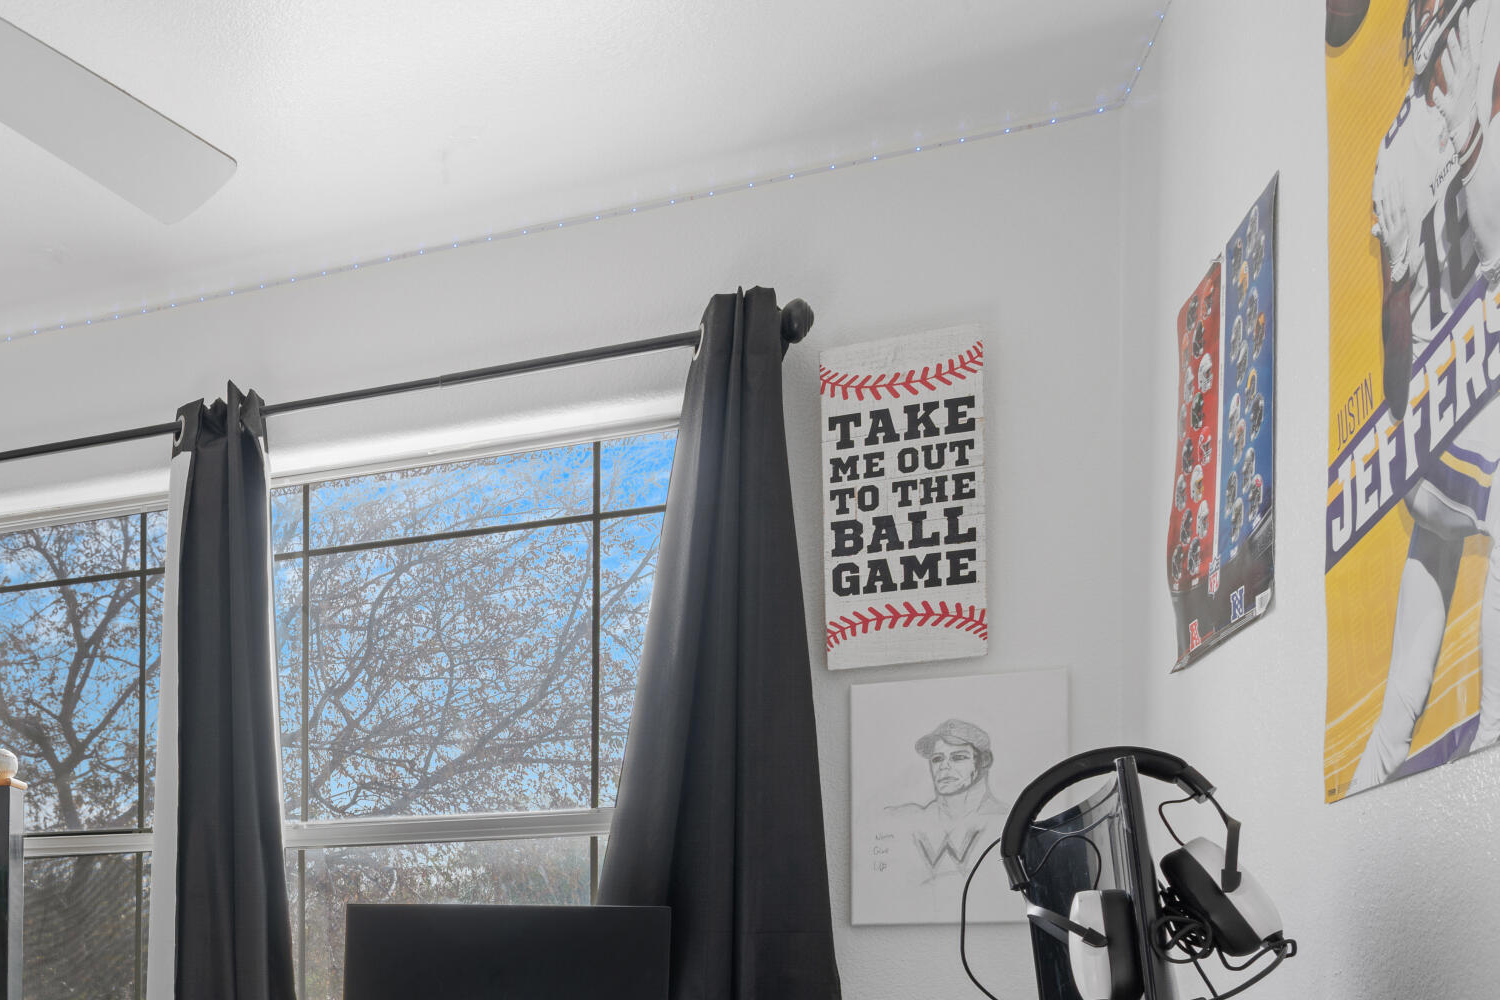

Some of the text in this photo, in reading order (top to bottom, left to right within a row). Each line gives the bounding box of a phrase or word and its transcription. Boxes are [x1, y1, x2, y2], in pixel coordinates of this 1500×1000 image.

[1429, 153, 1460, 197] VIKIN
[828, 395, 975, 450] TAKE
[1336, 372, 1374, 450] JUSTIN
[829, 439, 974, 483] ME OUT
[829, 471, 975, 515] TO THE
[831, 505, 976, 557] BALL
[832, 549, 976, 597] GAME
